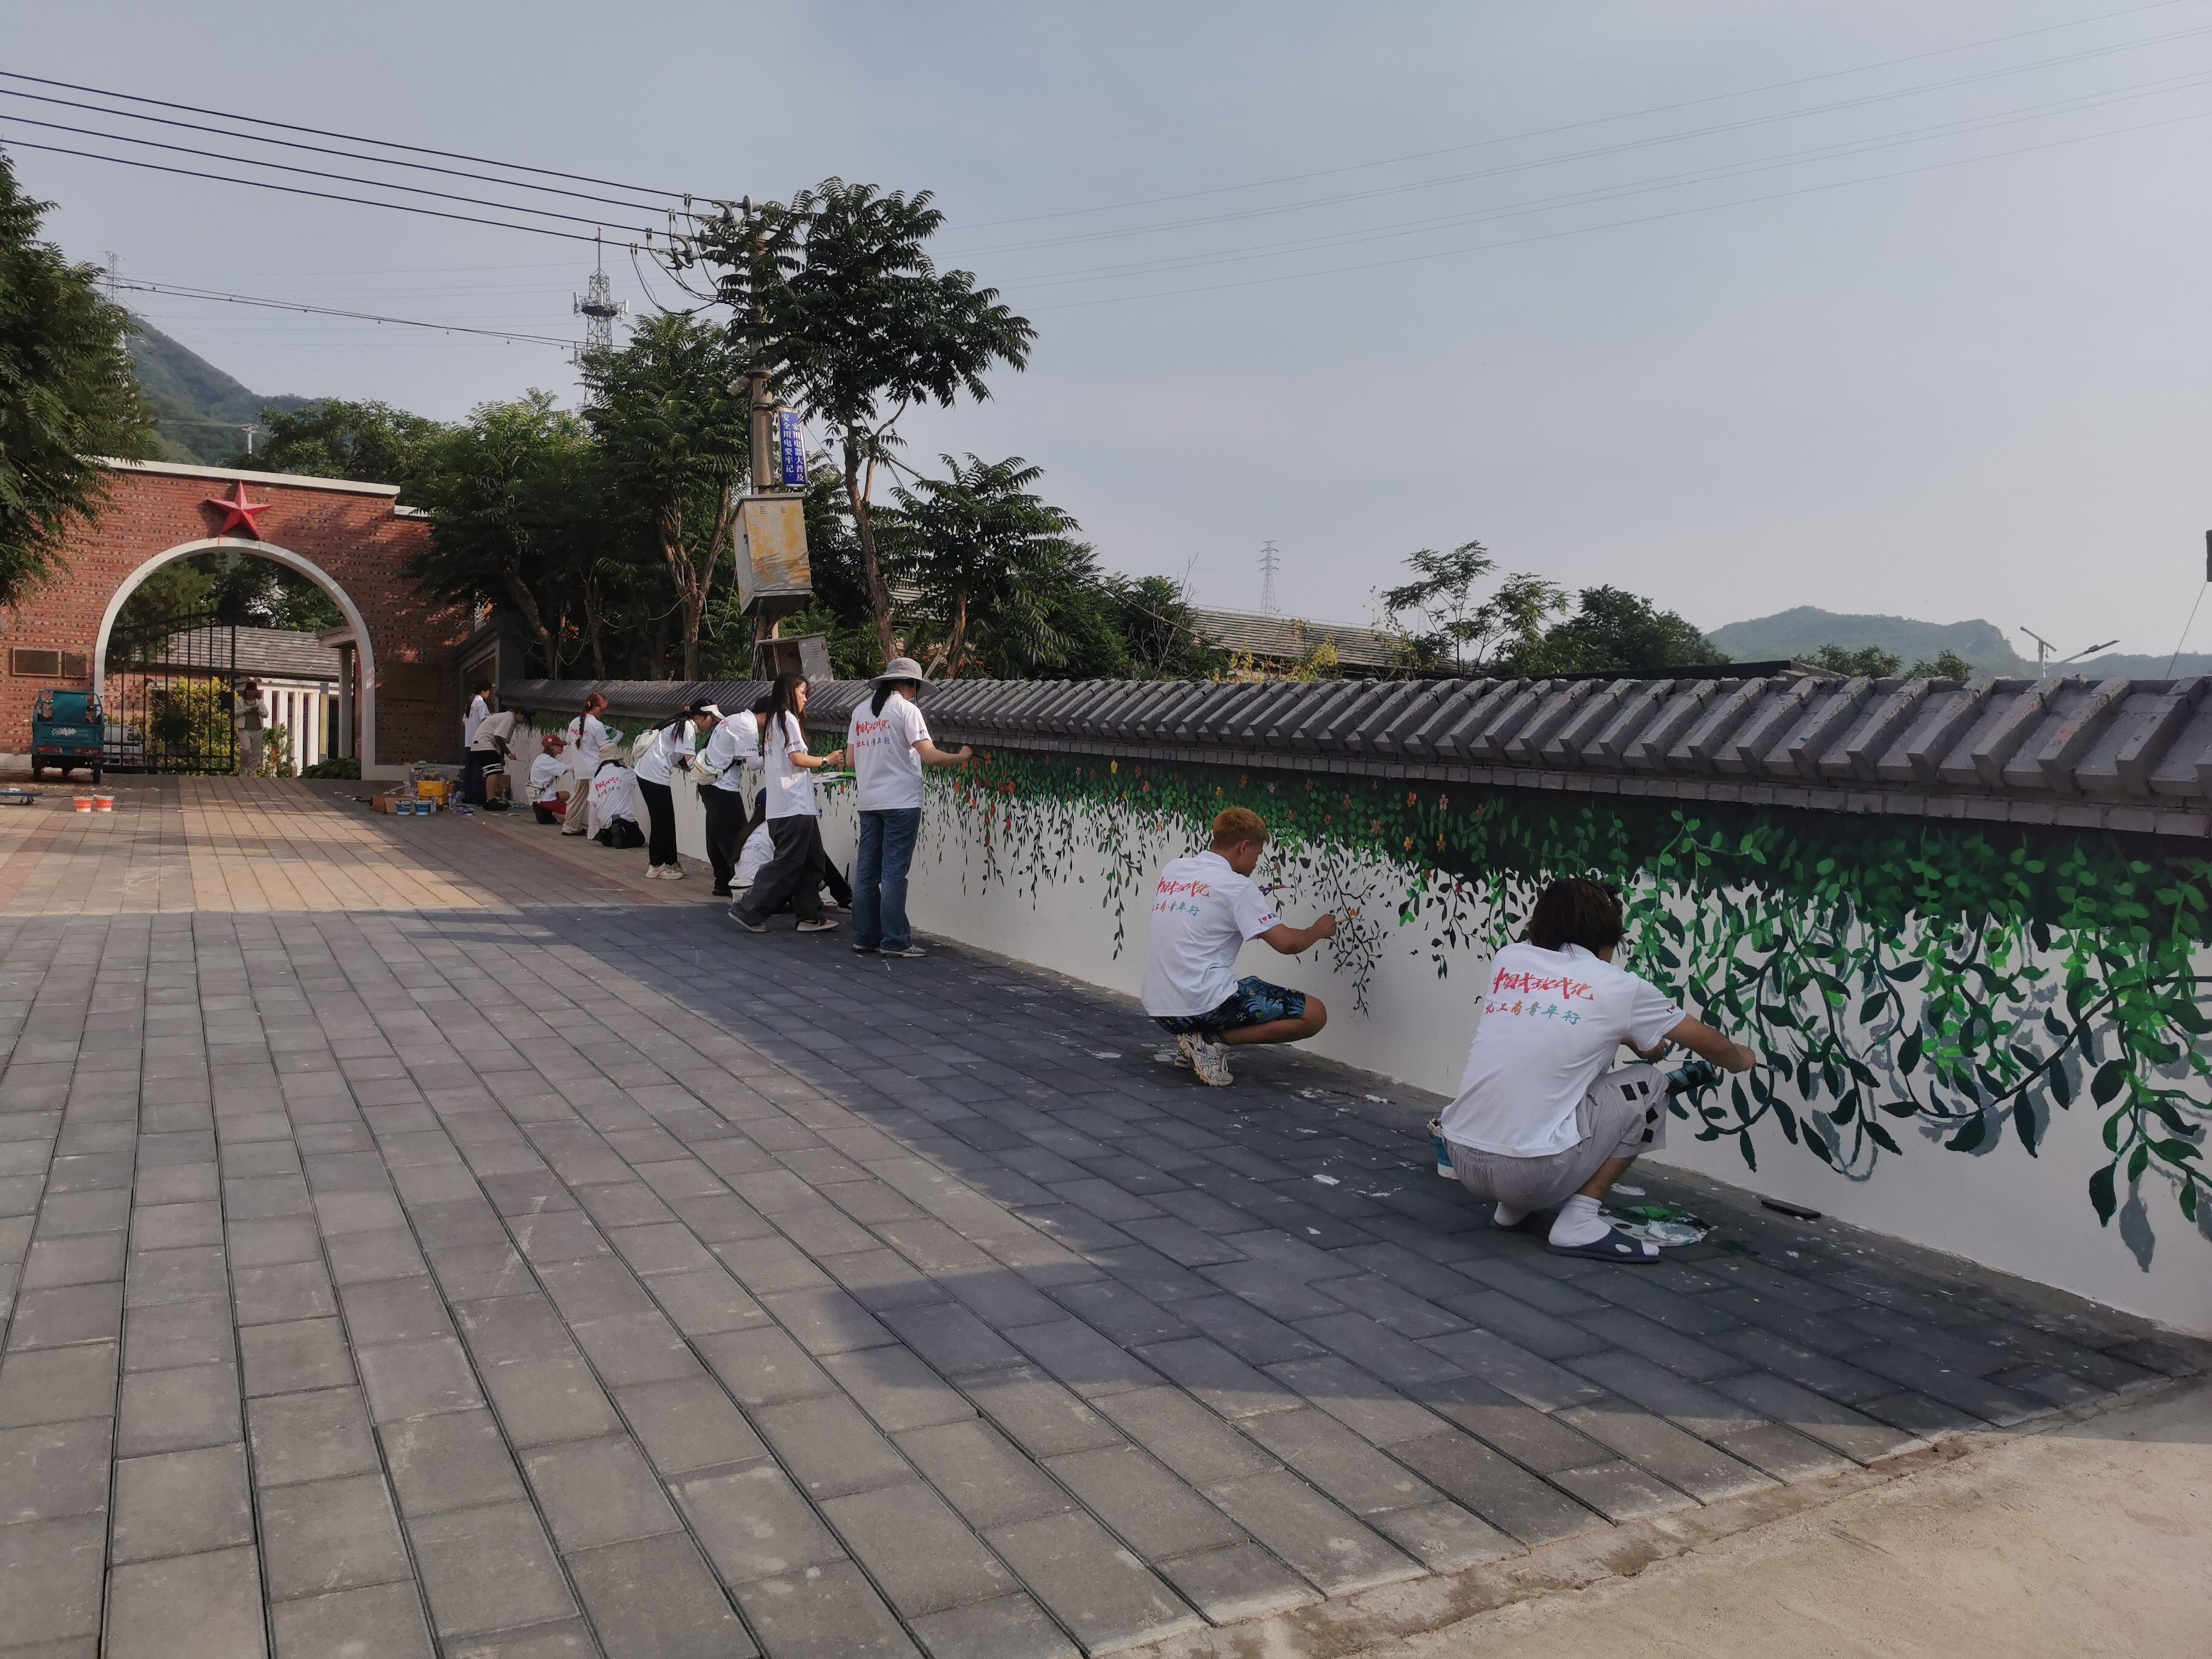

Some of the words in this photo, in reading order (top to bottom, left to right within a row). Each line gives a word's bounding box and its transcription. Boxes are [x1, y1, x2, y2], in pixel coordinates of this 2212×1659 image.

[1493, 967, 1595, 1001] 中国式现代化
[1484, 1000, 1581, 1025] 北工商青年行
